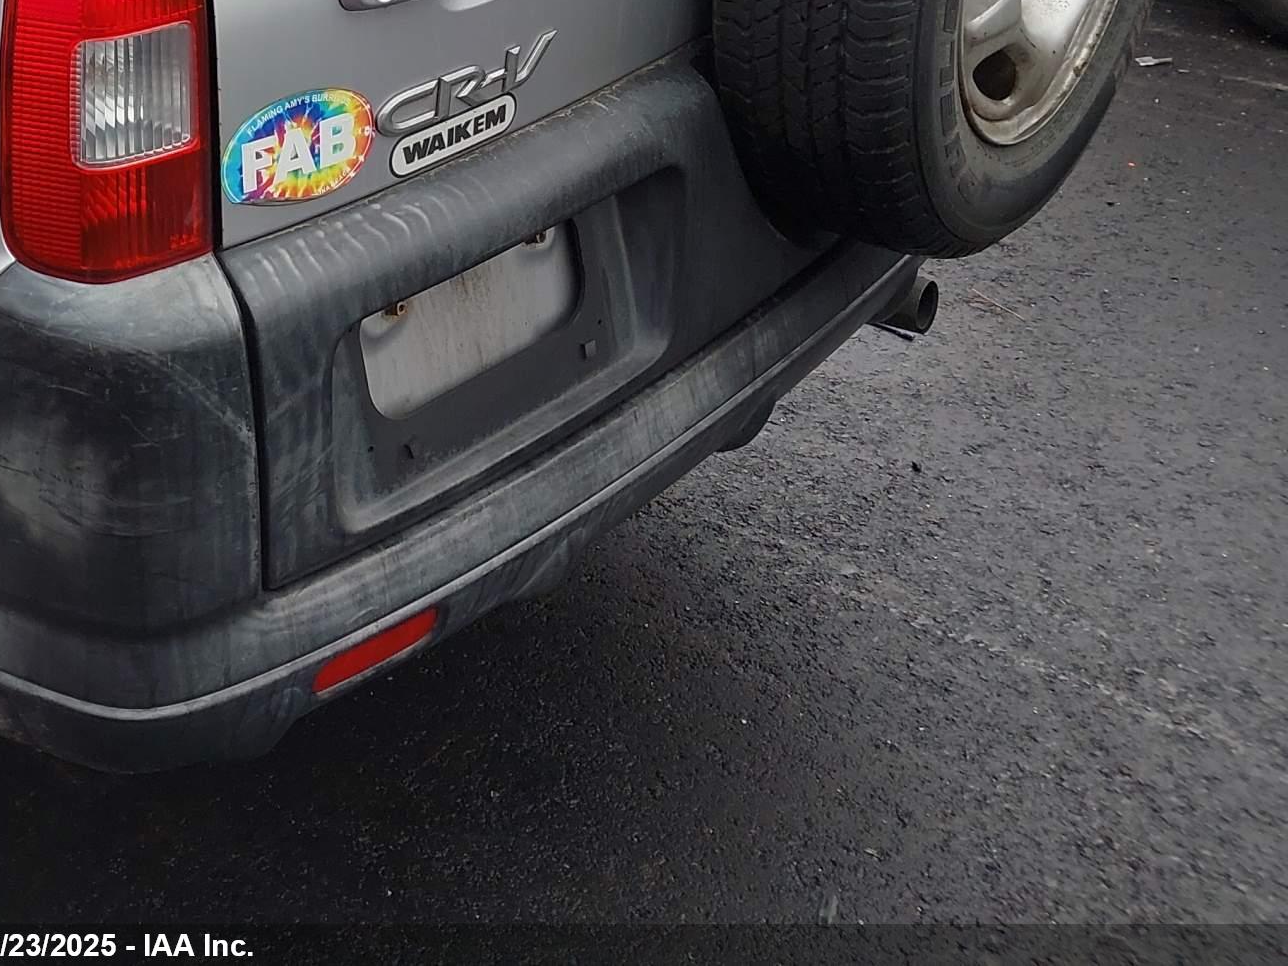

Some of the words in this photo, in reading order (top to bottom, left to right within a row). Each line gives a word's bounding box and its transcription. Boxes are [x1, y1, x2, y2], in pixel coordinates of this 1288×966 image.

[247, 104, 284, 137] FLAMING
[284, 95, 310, 110] AMY'S
[375, 28, 558, 137] CR-V
[240, 113, 357, 194] FAB
[402, 103, 507, 166] WAIKEM
